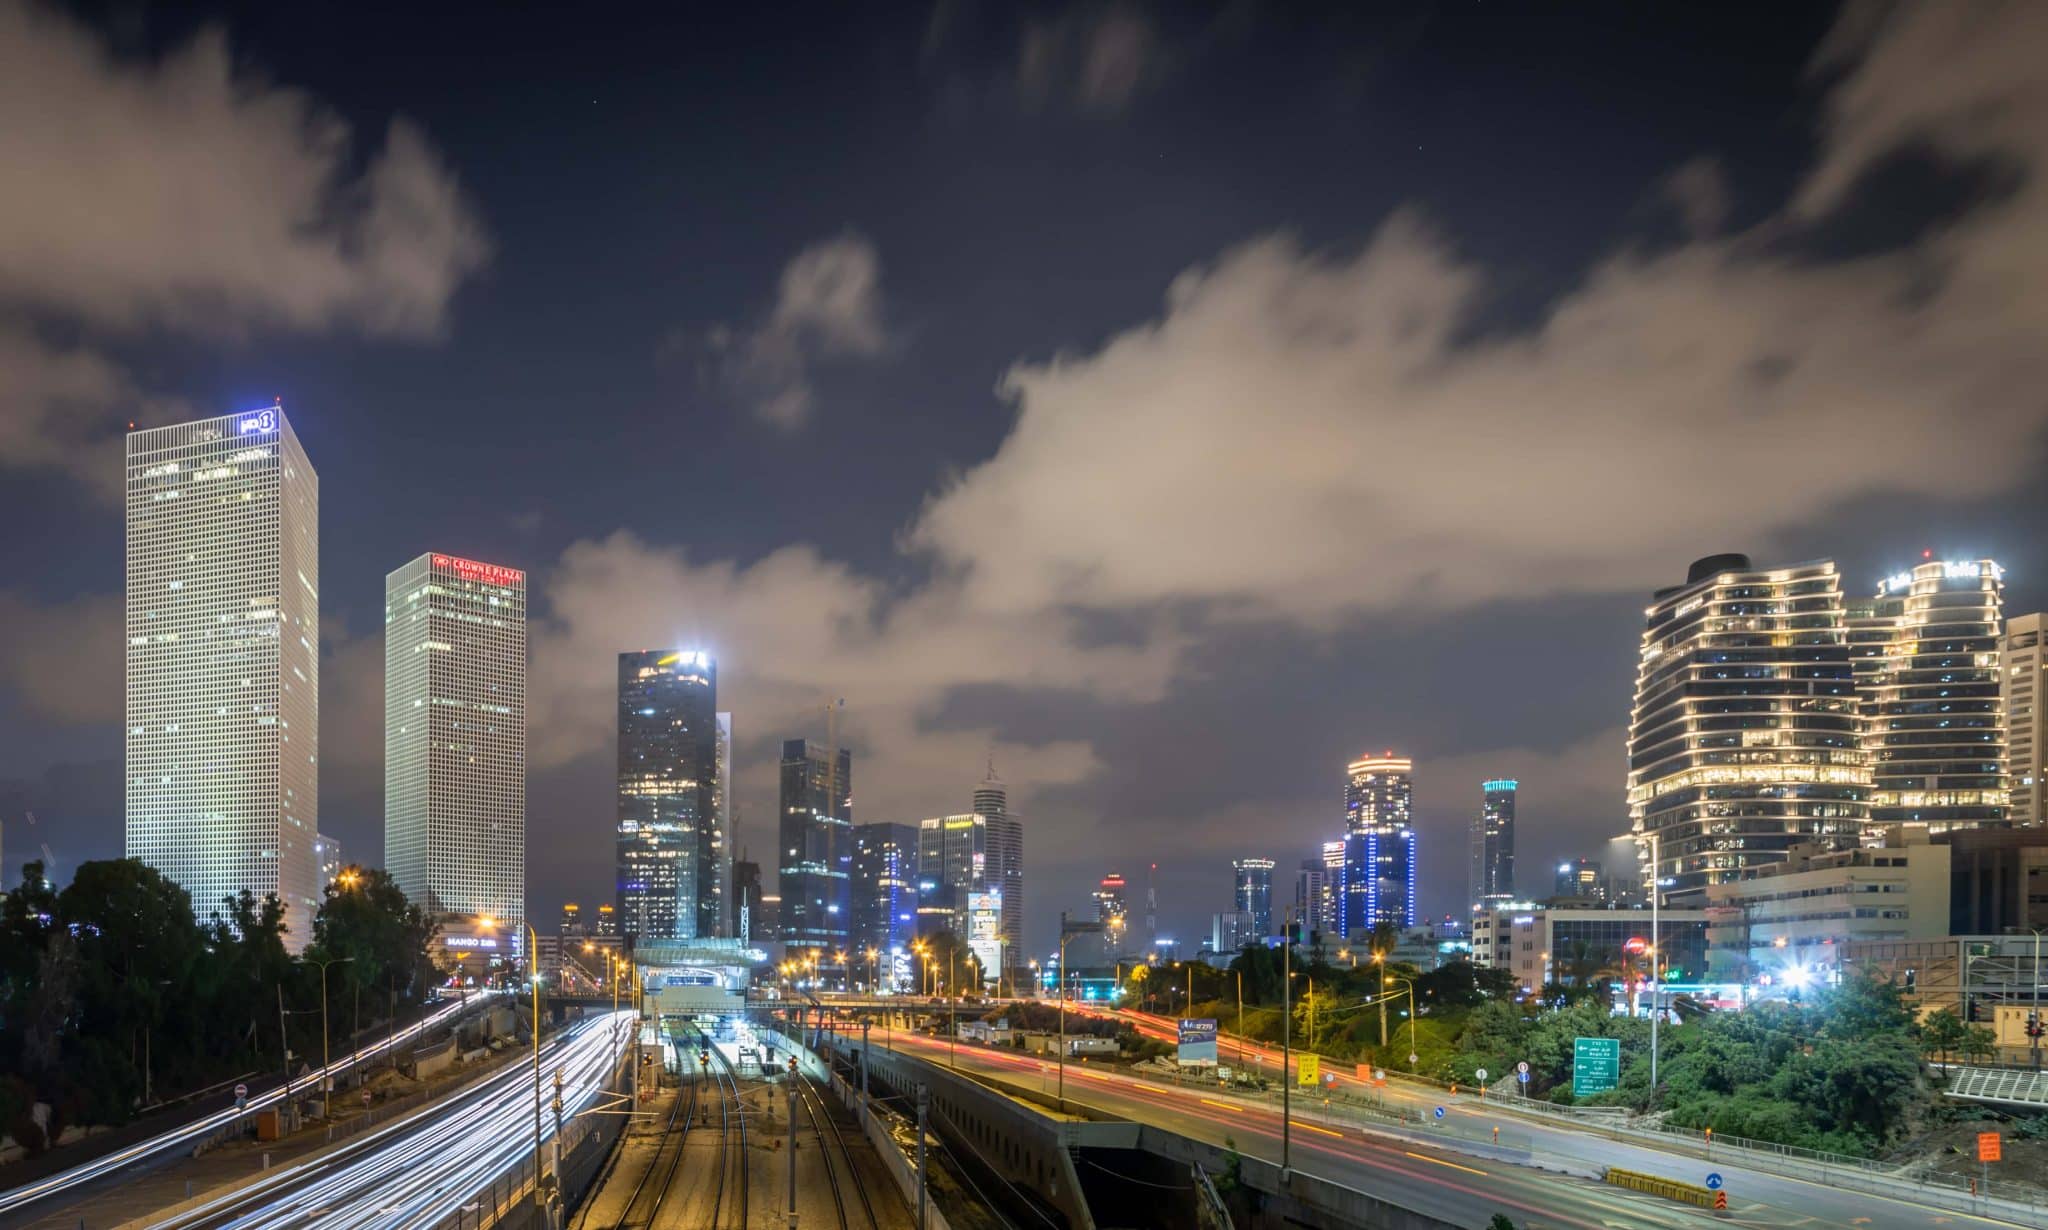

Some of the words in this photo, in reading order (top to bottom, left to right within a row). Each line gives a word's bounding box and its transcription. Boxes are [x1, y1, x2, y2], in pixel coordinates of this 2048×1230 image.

[453, 559, 491, 574] CROWNE
[493, 566, 521, 579] PLAZA
[447, 937, 479, 946] MANGO
